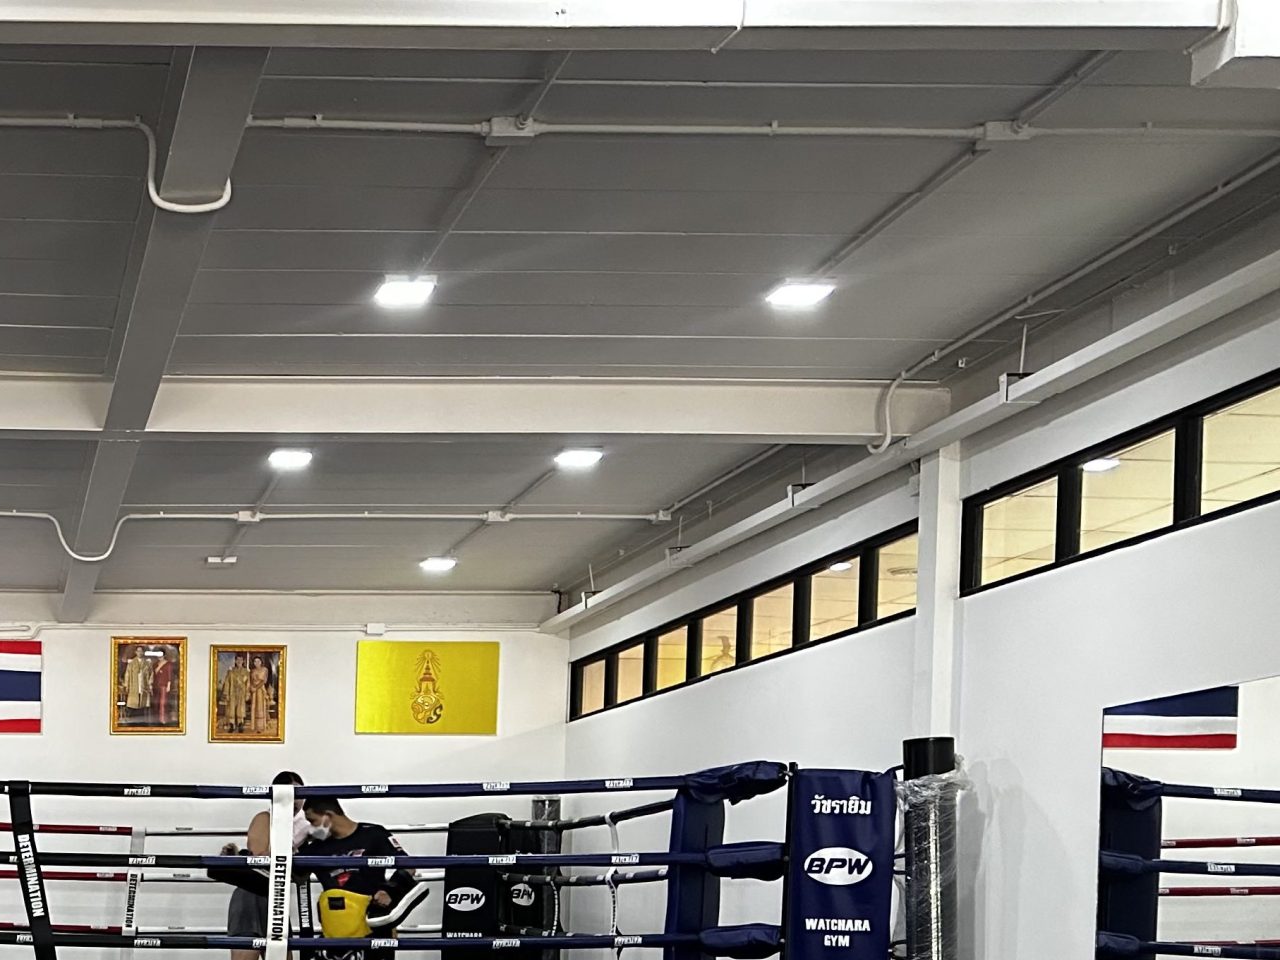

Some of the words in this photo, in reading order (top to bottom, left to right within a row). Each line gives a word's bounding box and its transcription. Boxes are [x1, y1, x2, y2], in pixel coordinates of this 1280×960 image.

[811, 794, 872, 815] วัชรายิม
[805, 857, 870, 875] BPW
[18, 834, 45, 917] DETERMINATION
[271, 855, 287, 942] DETERMINATION
[447, 893, 485, 905] BPW
[805, 918, 871, 932] WATCHARA
[824, 935, 850, 947] GYM
